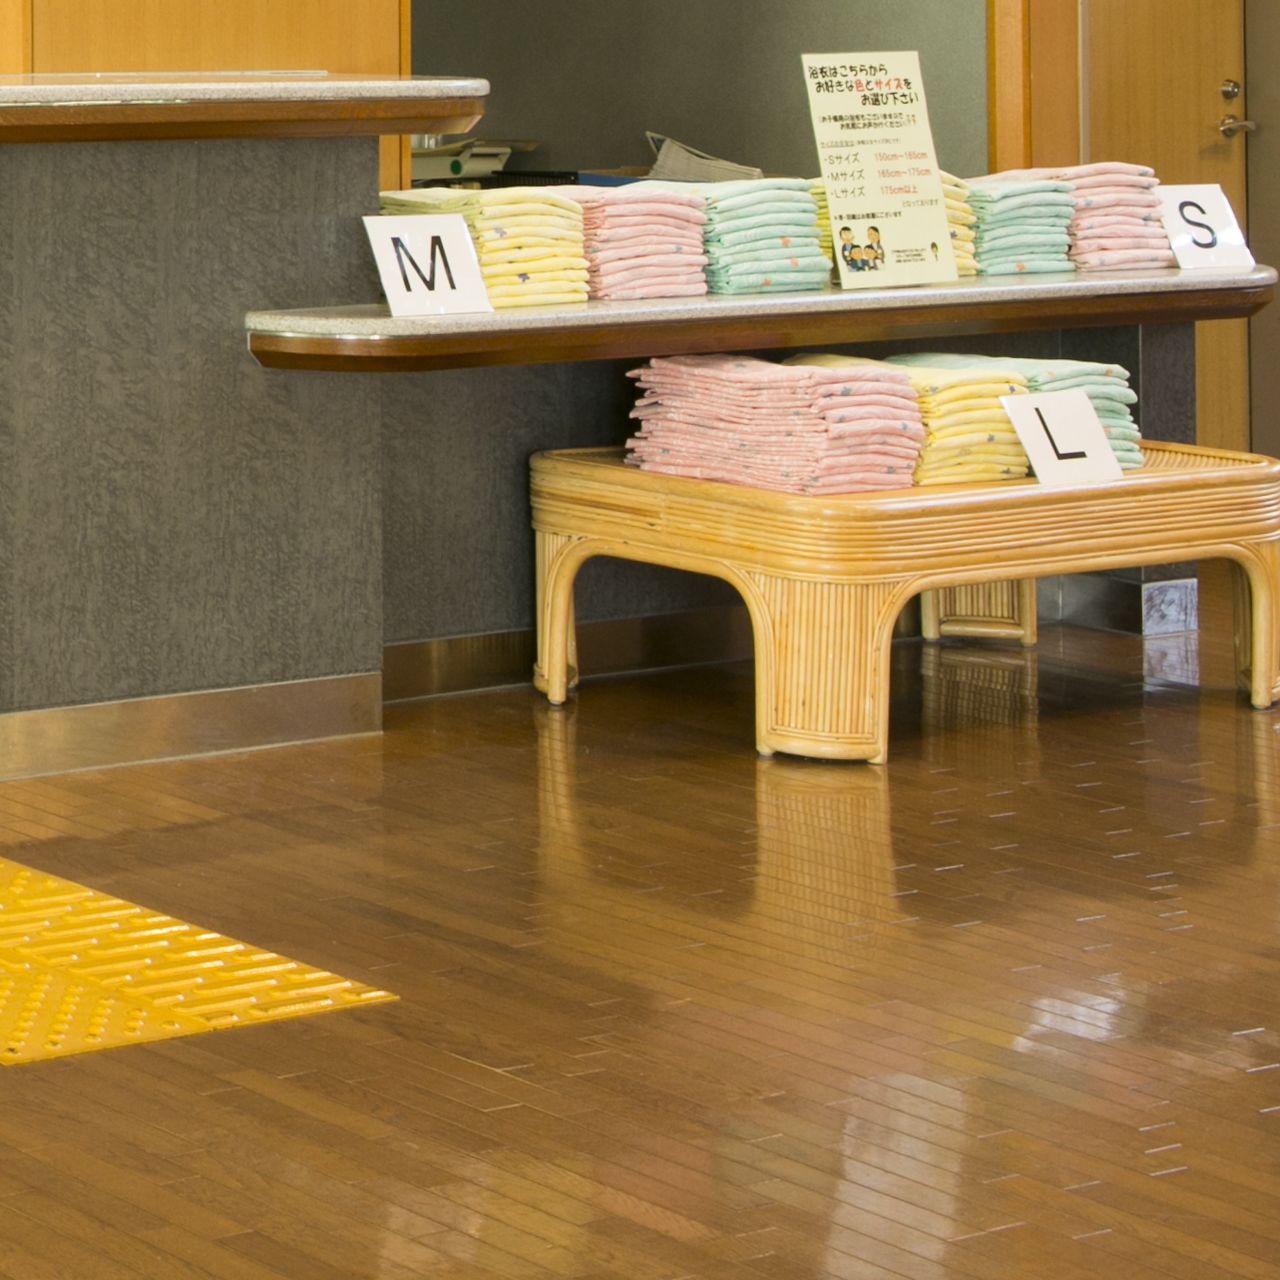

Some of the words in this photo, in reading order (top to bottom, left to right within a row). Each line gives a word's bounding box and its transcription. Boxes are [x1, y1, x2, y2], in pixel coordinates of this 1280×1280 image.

[808, 64, 888, 79] 浴衣はこちらから
[815, 78, 912, 93] お好きな色とサイズを
[861, 92, 919, 106] お選び下さい
[1178, 200, 1218, 249] S
[390, 235, 457, 293] M
[1034, 406, 1088, 461] L
